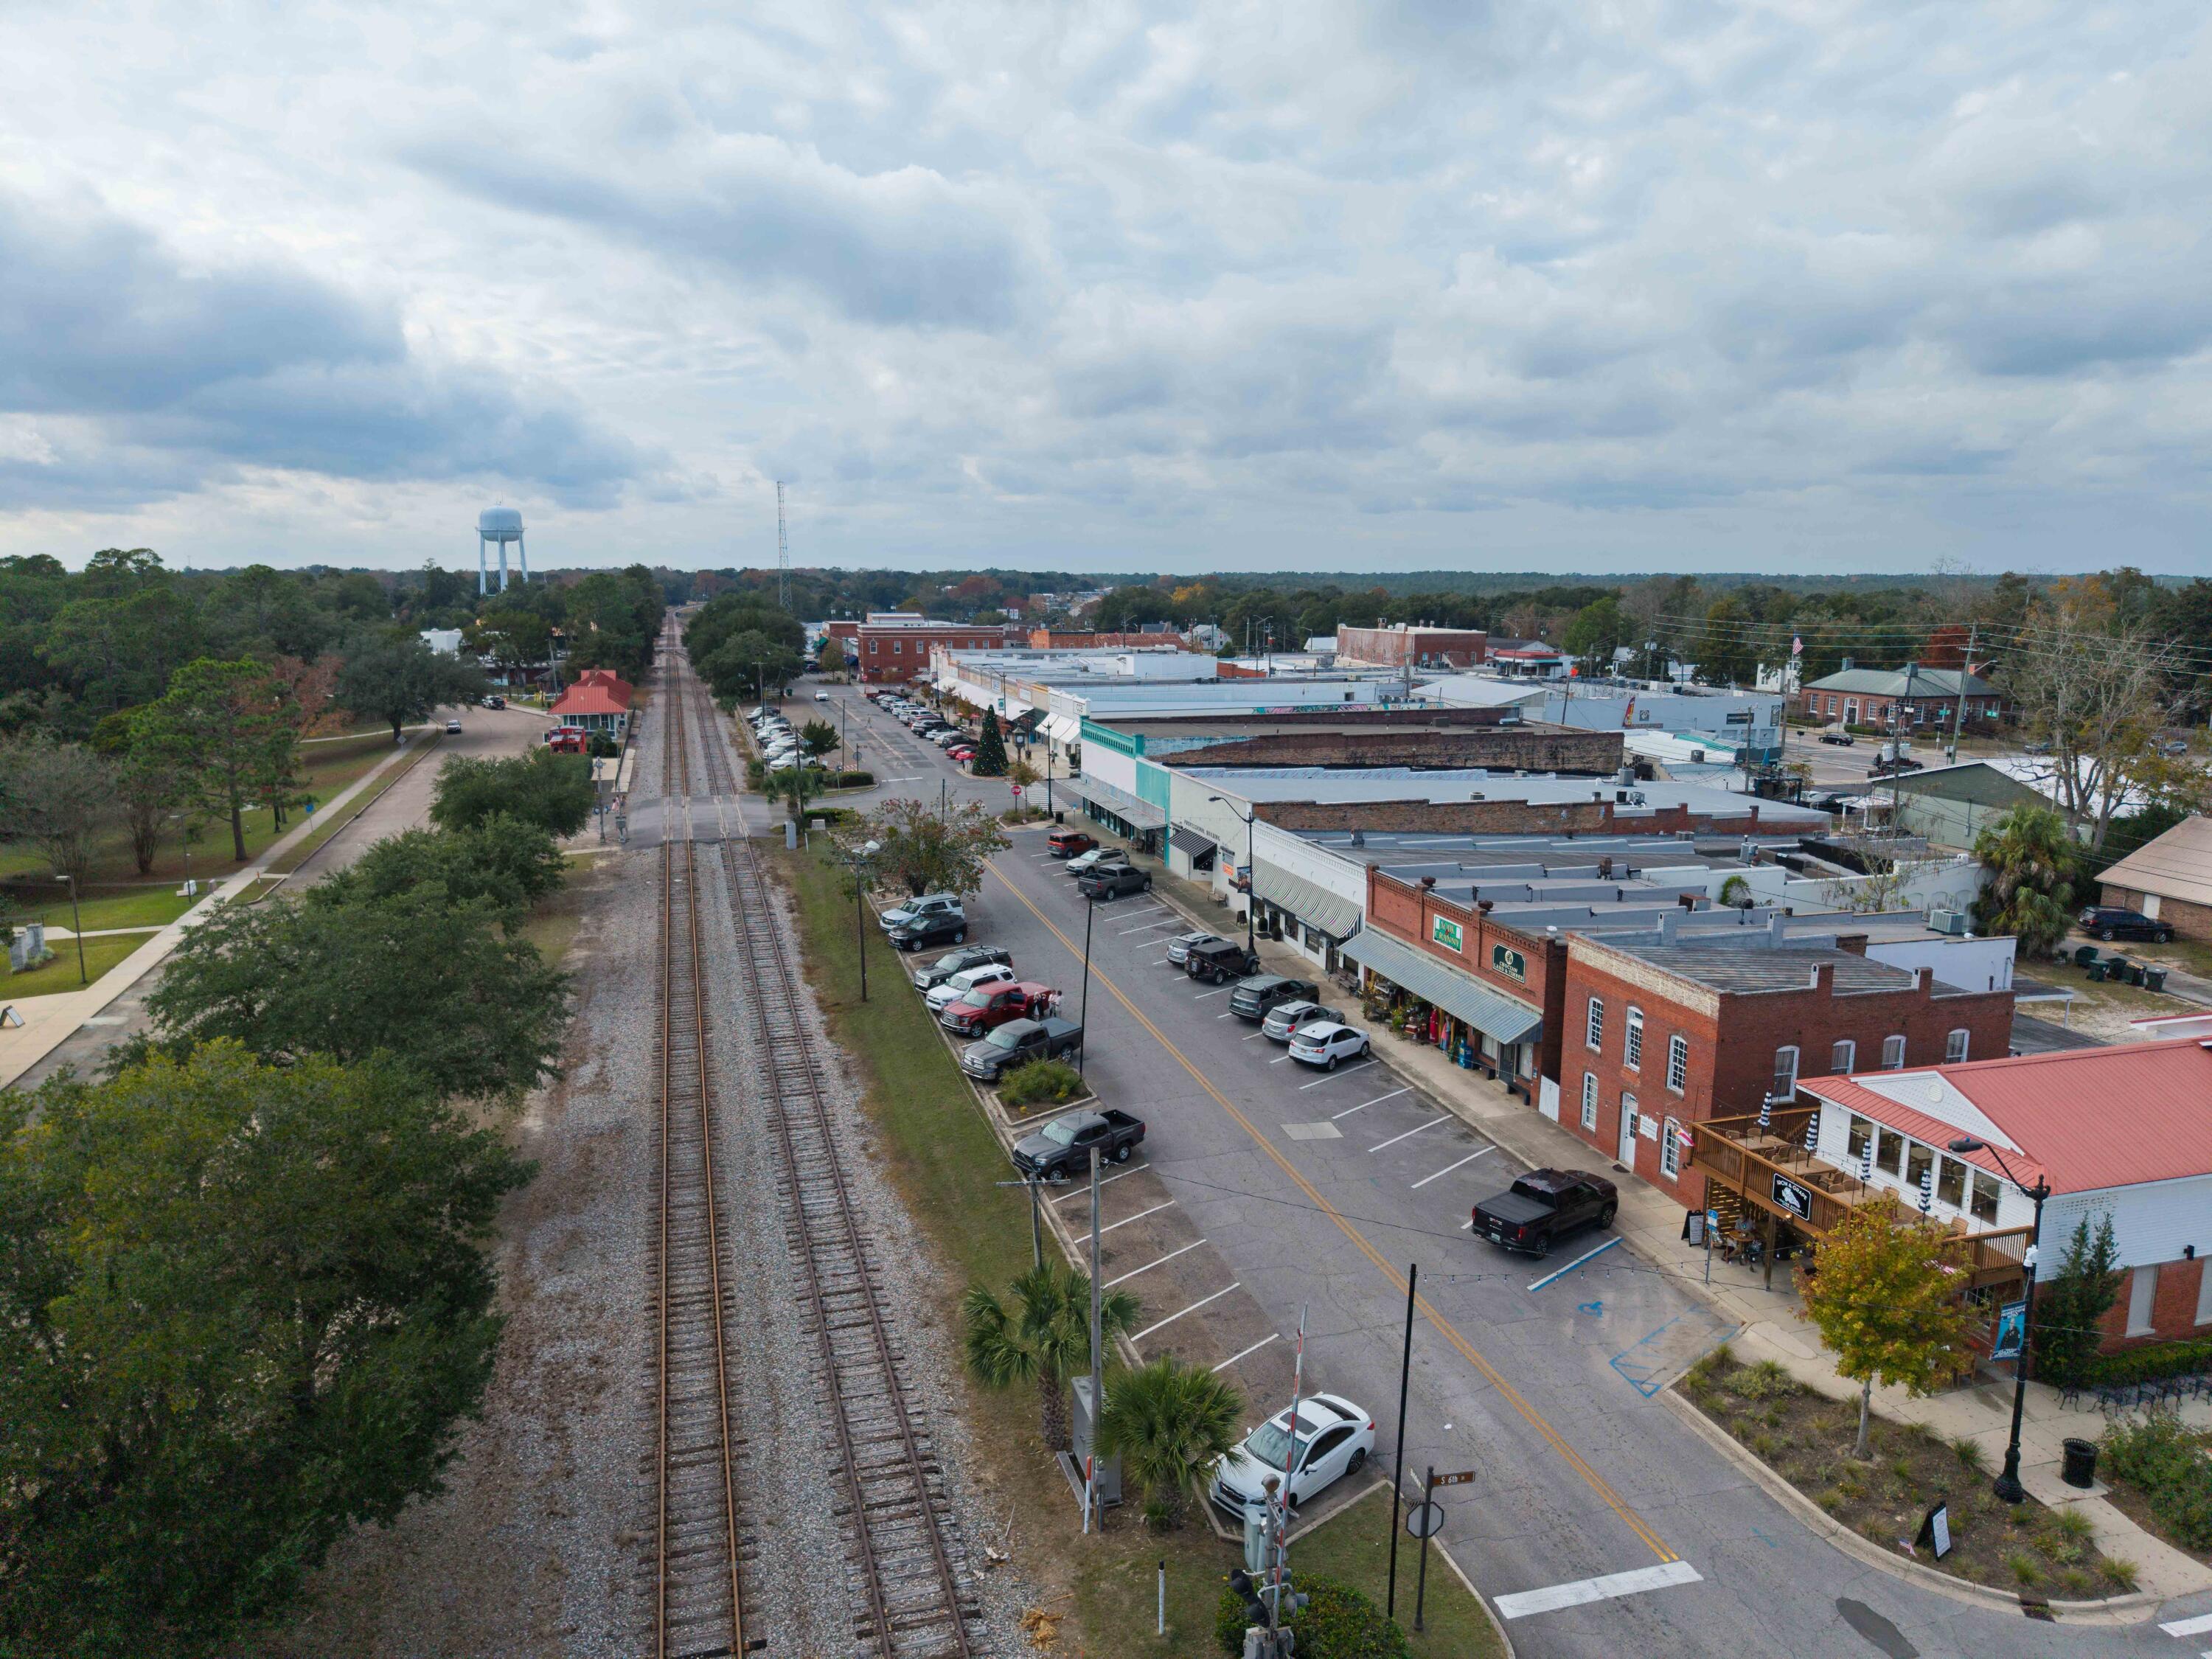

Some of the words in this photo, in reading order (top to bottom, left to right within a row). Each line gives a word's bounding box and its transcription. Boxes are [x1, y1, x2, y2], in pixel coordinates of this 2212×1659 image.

[1184, 819, 1204, 834] PROFESSIONAL
[1206, 830, 1221, 841] BUILDING
[1435, 931, 1459, 947] CRANNY
[1494, 962, 1505, 972] LAND
[1499, 961, 1518, 973] CHOCTAW
[1792, 1185, 1807, 1201] GRAPE
[1448, 1475, 1458, 1484] 6th
